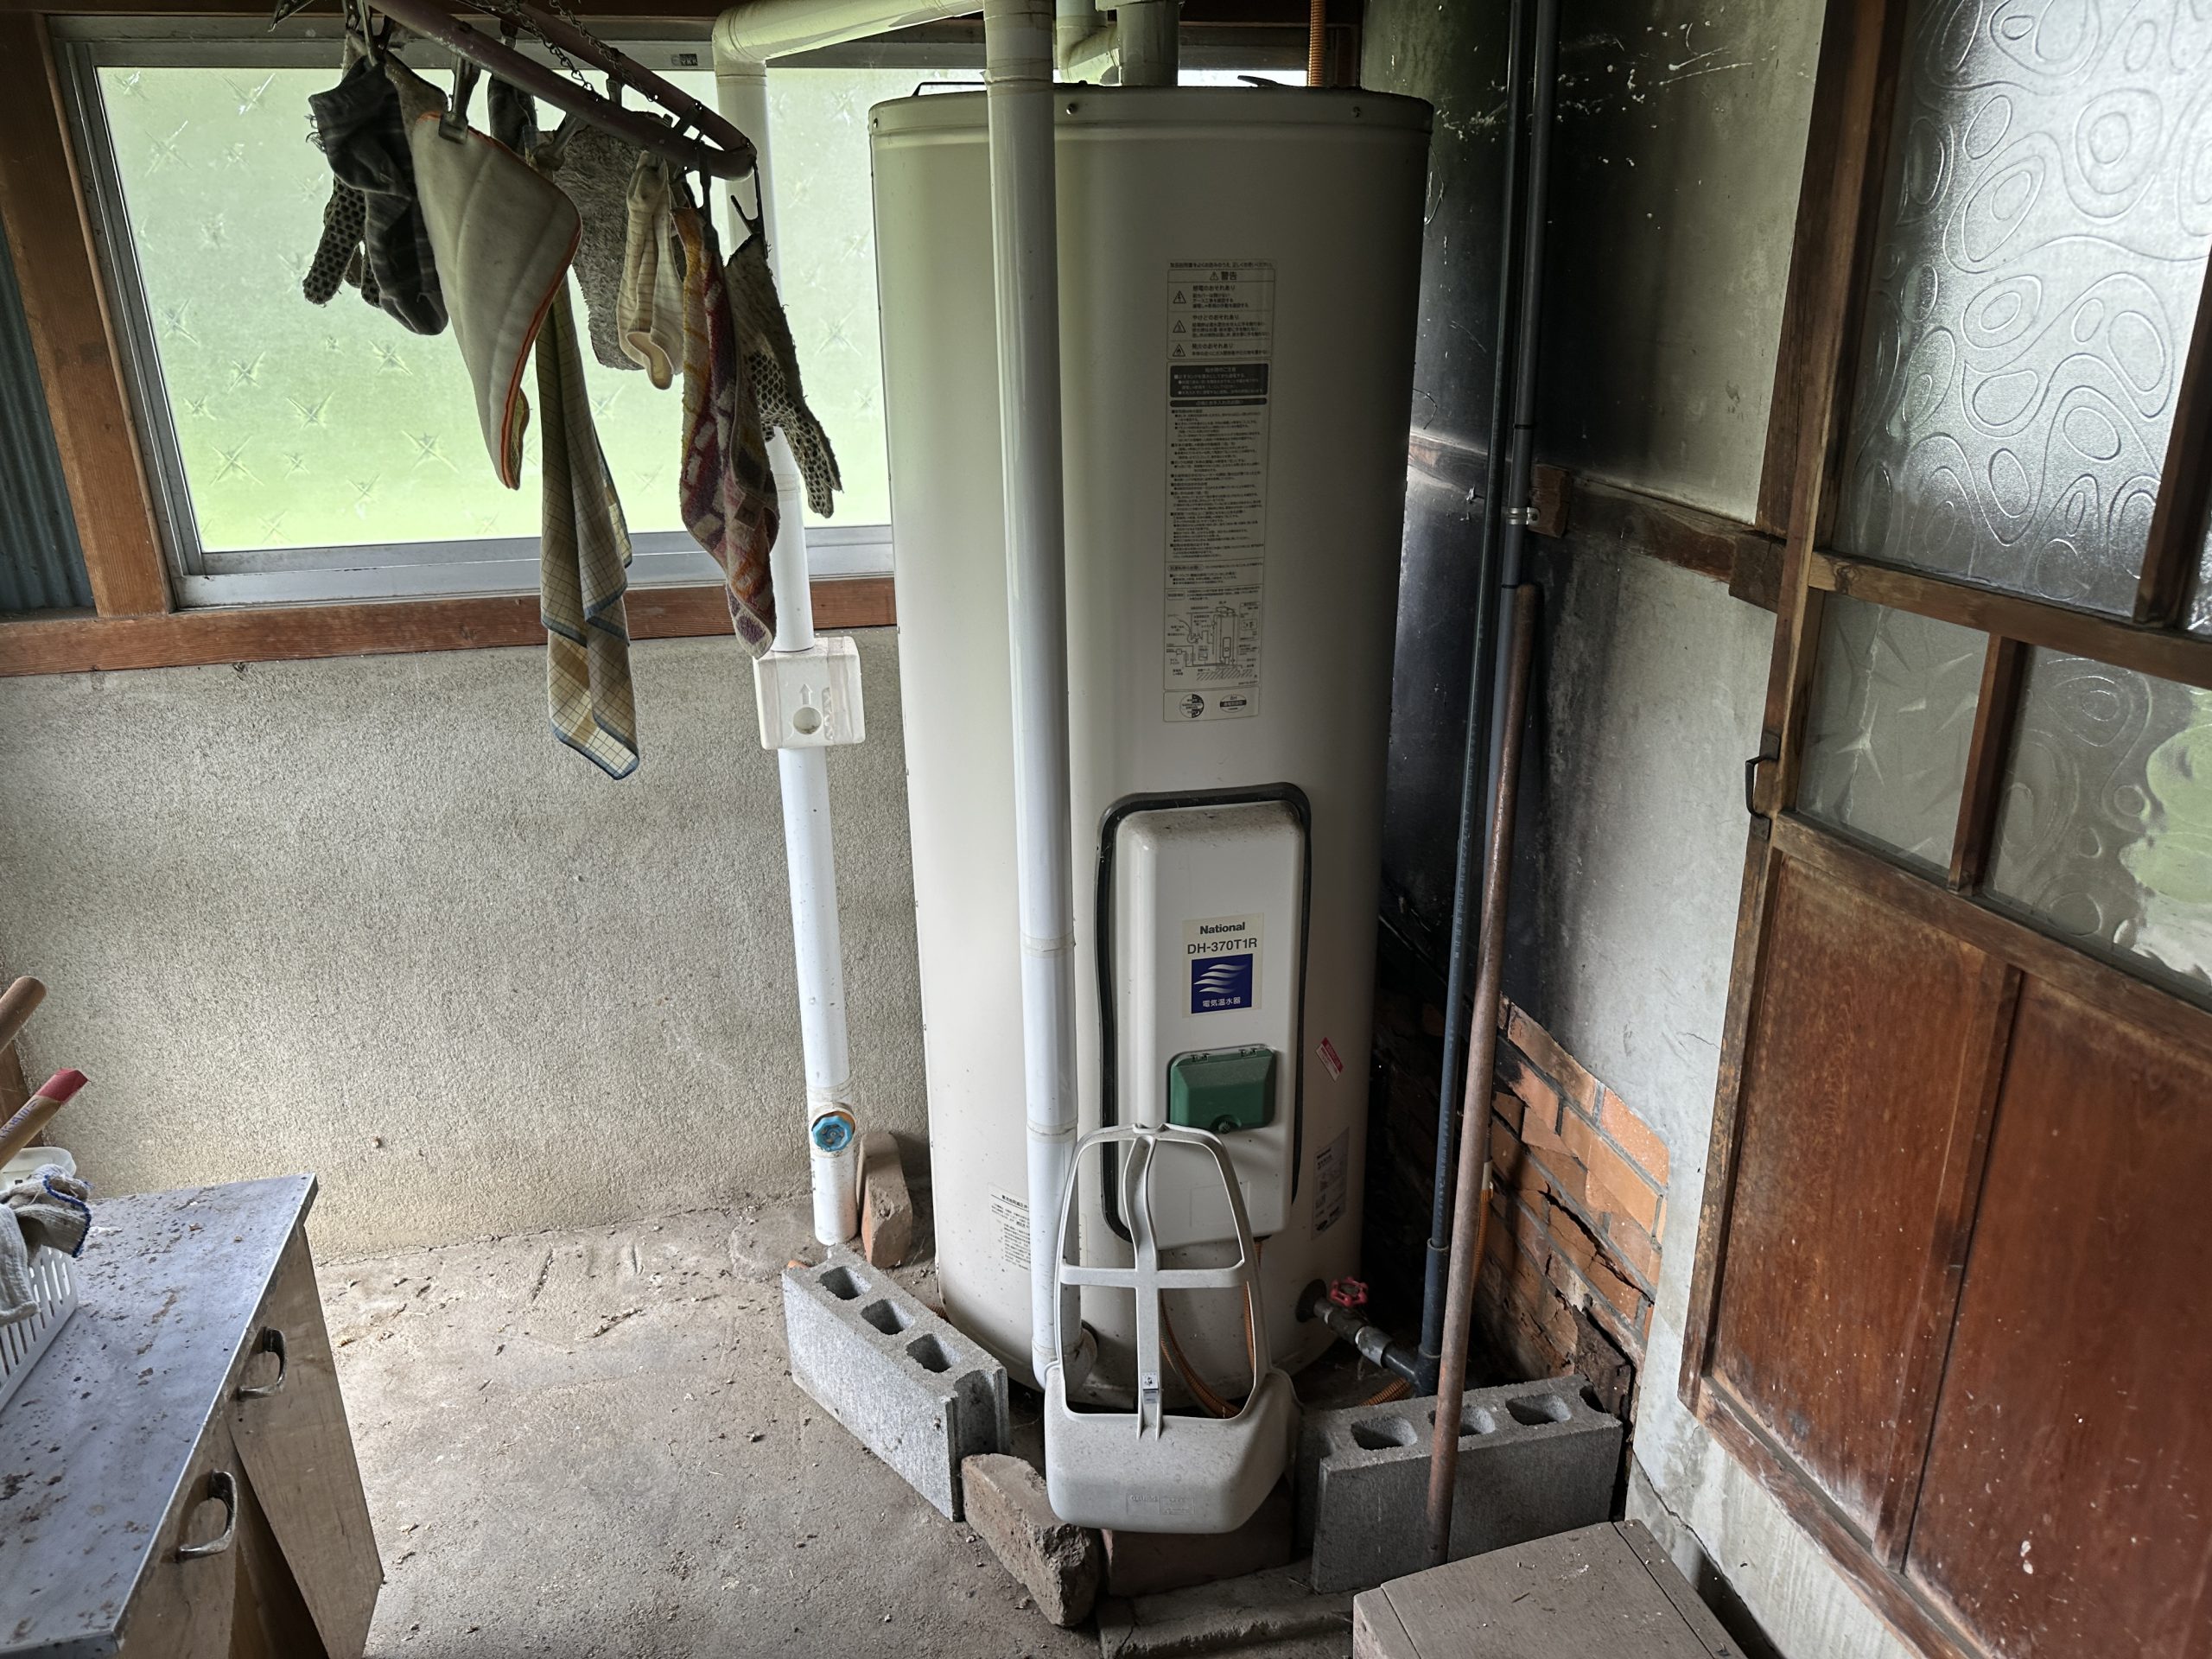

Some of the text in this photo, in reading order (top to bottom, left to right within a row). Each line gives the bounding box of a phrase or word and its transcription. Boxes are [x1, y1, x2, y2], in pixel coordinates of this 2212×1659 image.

[1221, 271, 1237, 281] 警告
[1199, 921, 1246, 935] National
[1187, 938, 1258, 955] DH-370T1R
[1202, 996, 1242, 1007] 電気温水器
